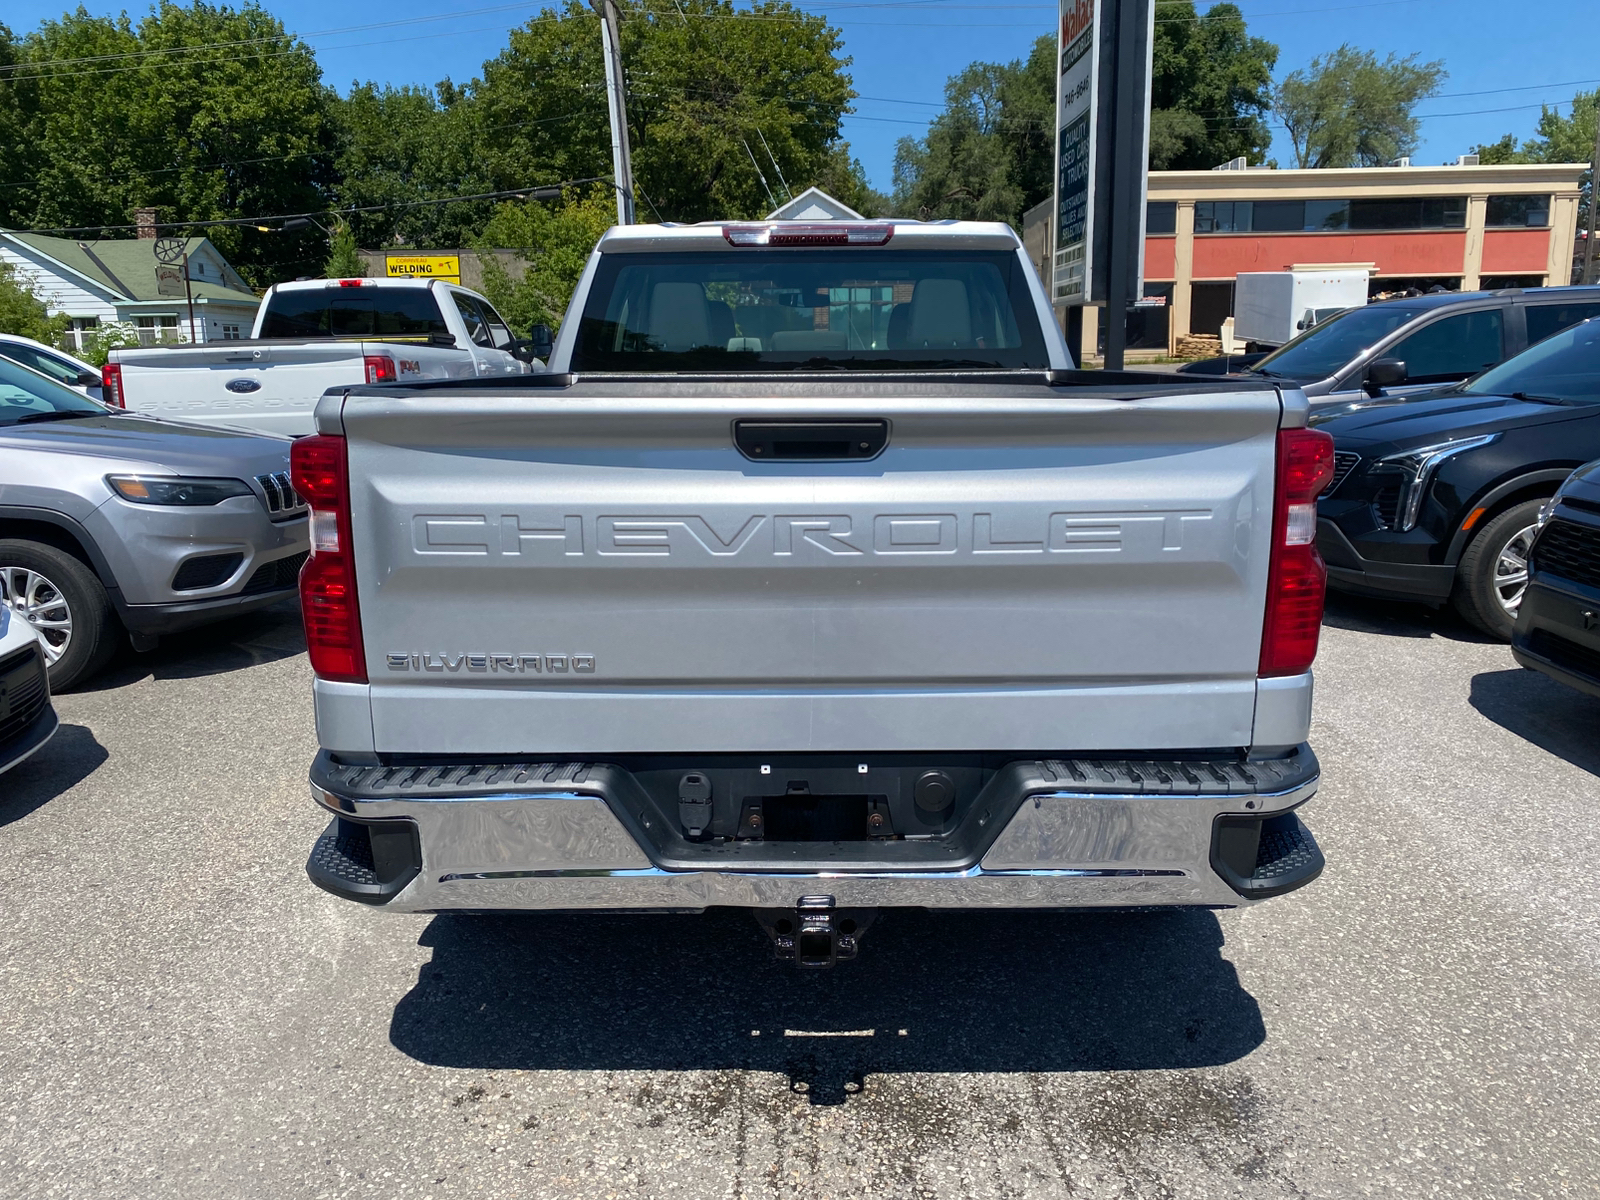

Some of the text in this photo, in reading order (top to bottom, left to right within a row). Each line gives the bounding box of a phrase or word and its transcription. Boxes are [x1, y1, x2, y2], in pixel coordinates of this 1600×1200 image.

[1065, 120, 1087, 148] QUALITY
[1060, 137, 1090, 169] USED CARS
[1060, 157, 1089, 189] & TRUCKS
[1060, 189, 1088, 213] OUTSTANDING
[1061, 210, 1077, 226] VALUES
[390, 265, 432, 273] WELDING
[234, 381, 253, 390] Ford
[139, 399, 254, 412] SUPER
[412, 508, 1213, 555] CHEVROLET
[386, 651, 596, 673] SILVERADO
